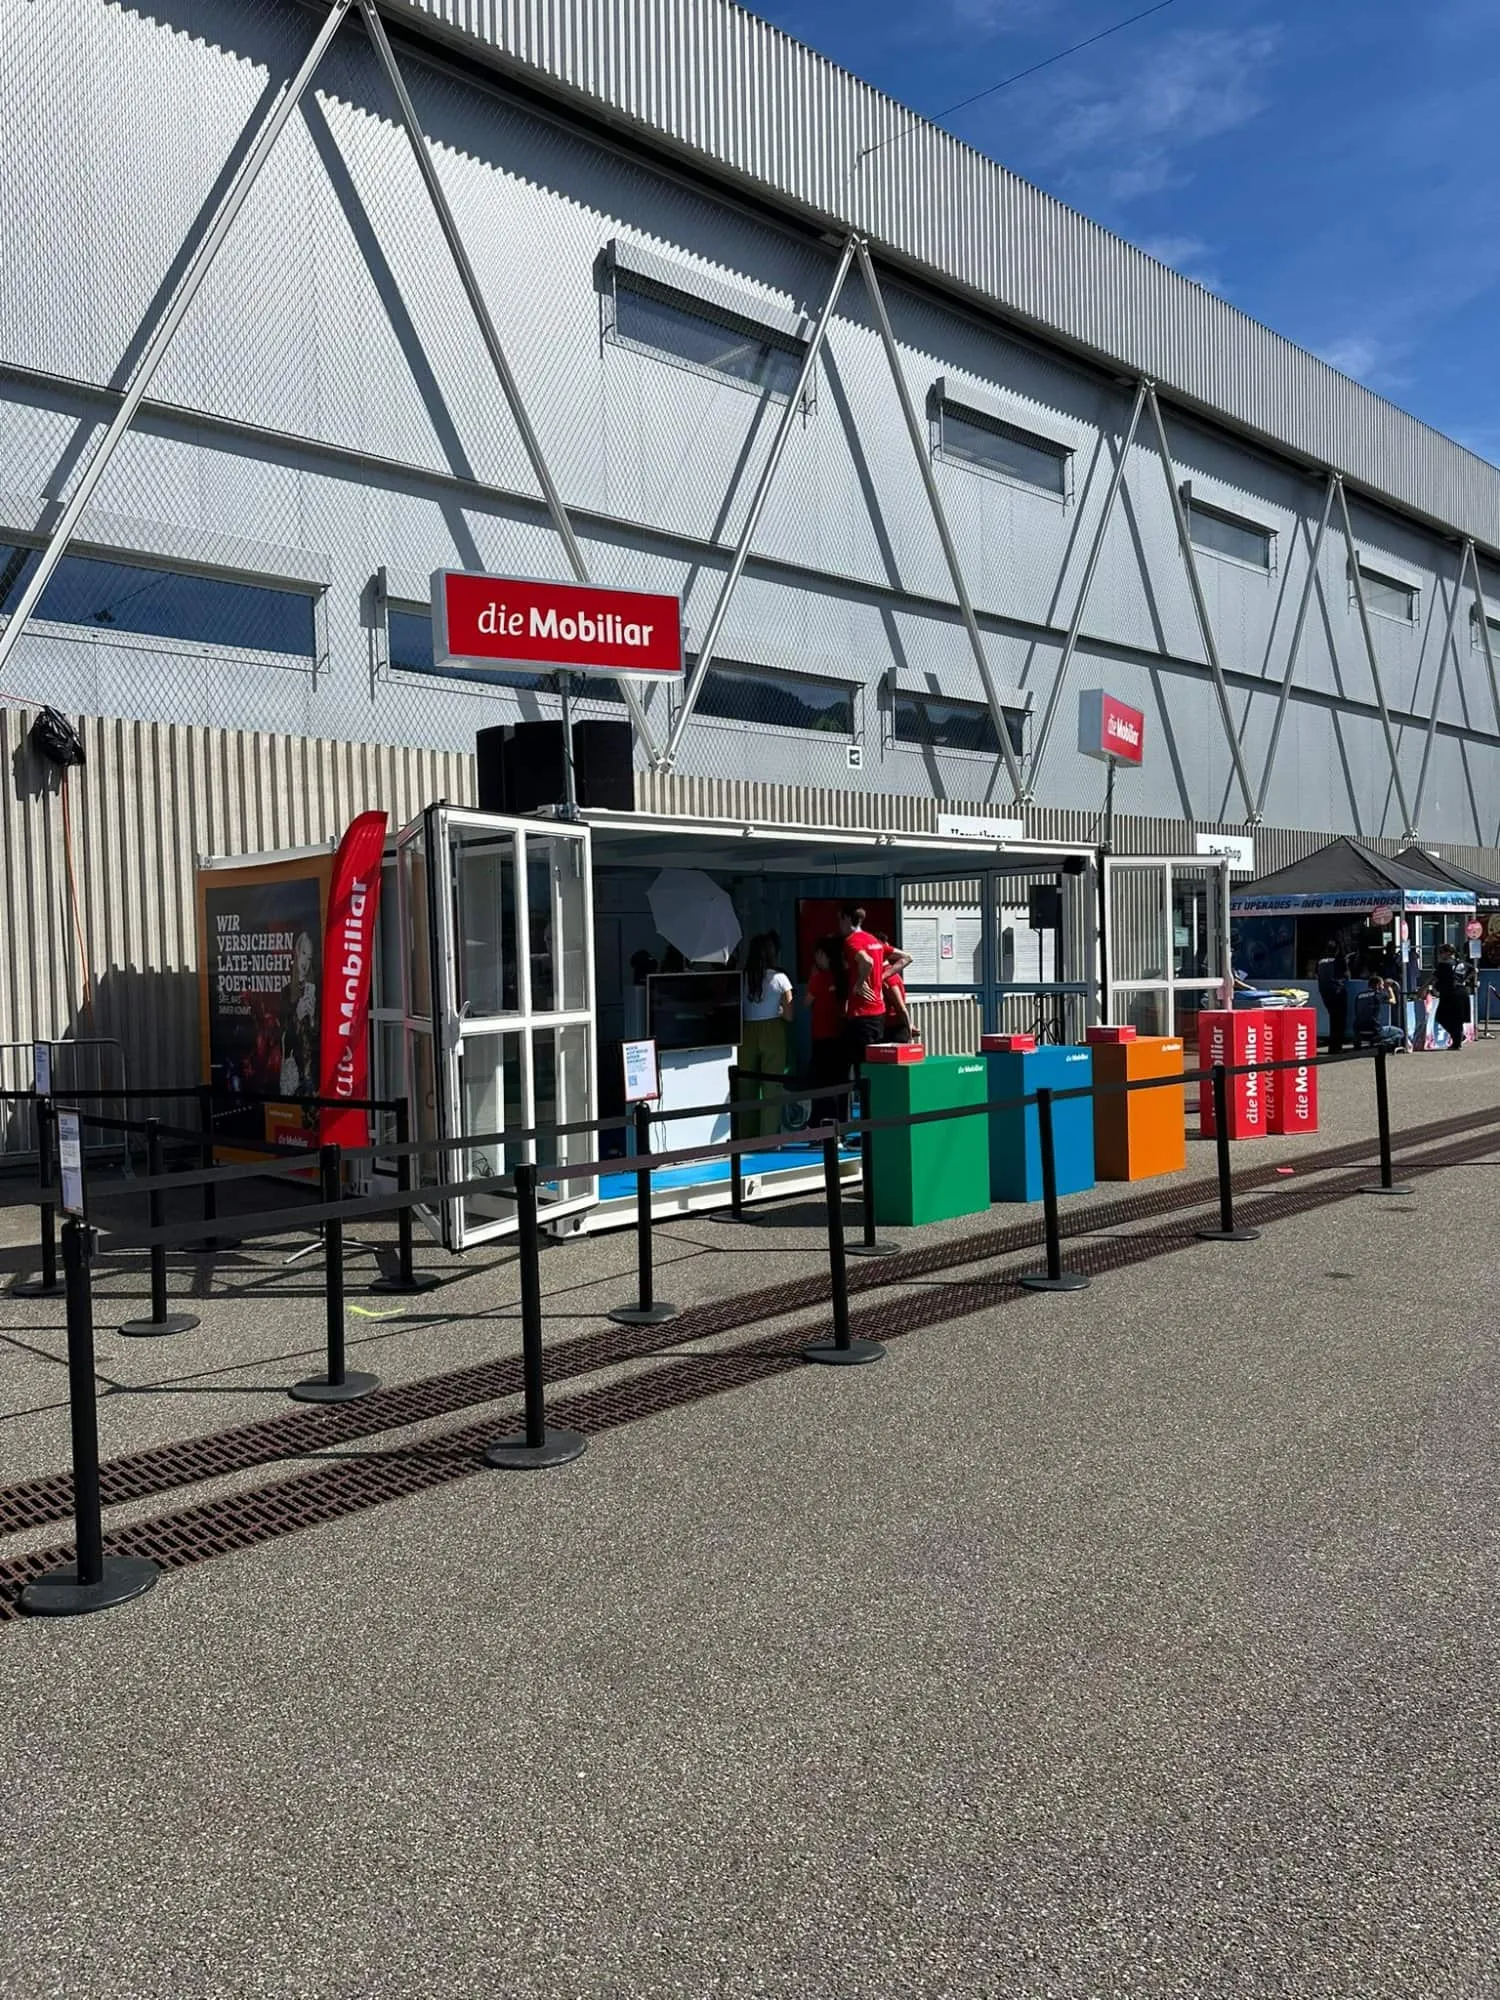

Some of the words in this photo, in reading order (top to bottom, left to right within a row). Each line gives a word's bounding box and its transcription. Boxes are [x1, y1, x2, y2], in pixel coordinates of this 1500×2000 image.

[477, 603, 524, 636] die
[529, 607, 654, 646] Mobiliar
[1244, 900, 1290, 910] UPGRADES
[1302, 899, 1323, 909] INFO
[1335, 896, 1400, 908] MERCHANDISE
[216, 914, 240, 932] WIR
[216, 932, 294, 952] VERSICHERN
[217, 954, 294, 972] LATE-NIGHT-
[1246, 1099, 1258, 1123] die
[1295, 1095, 1308, 1119] die
